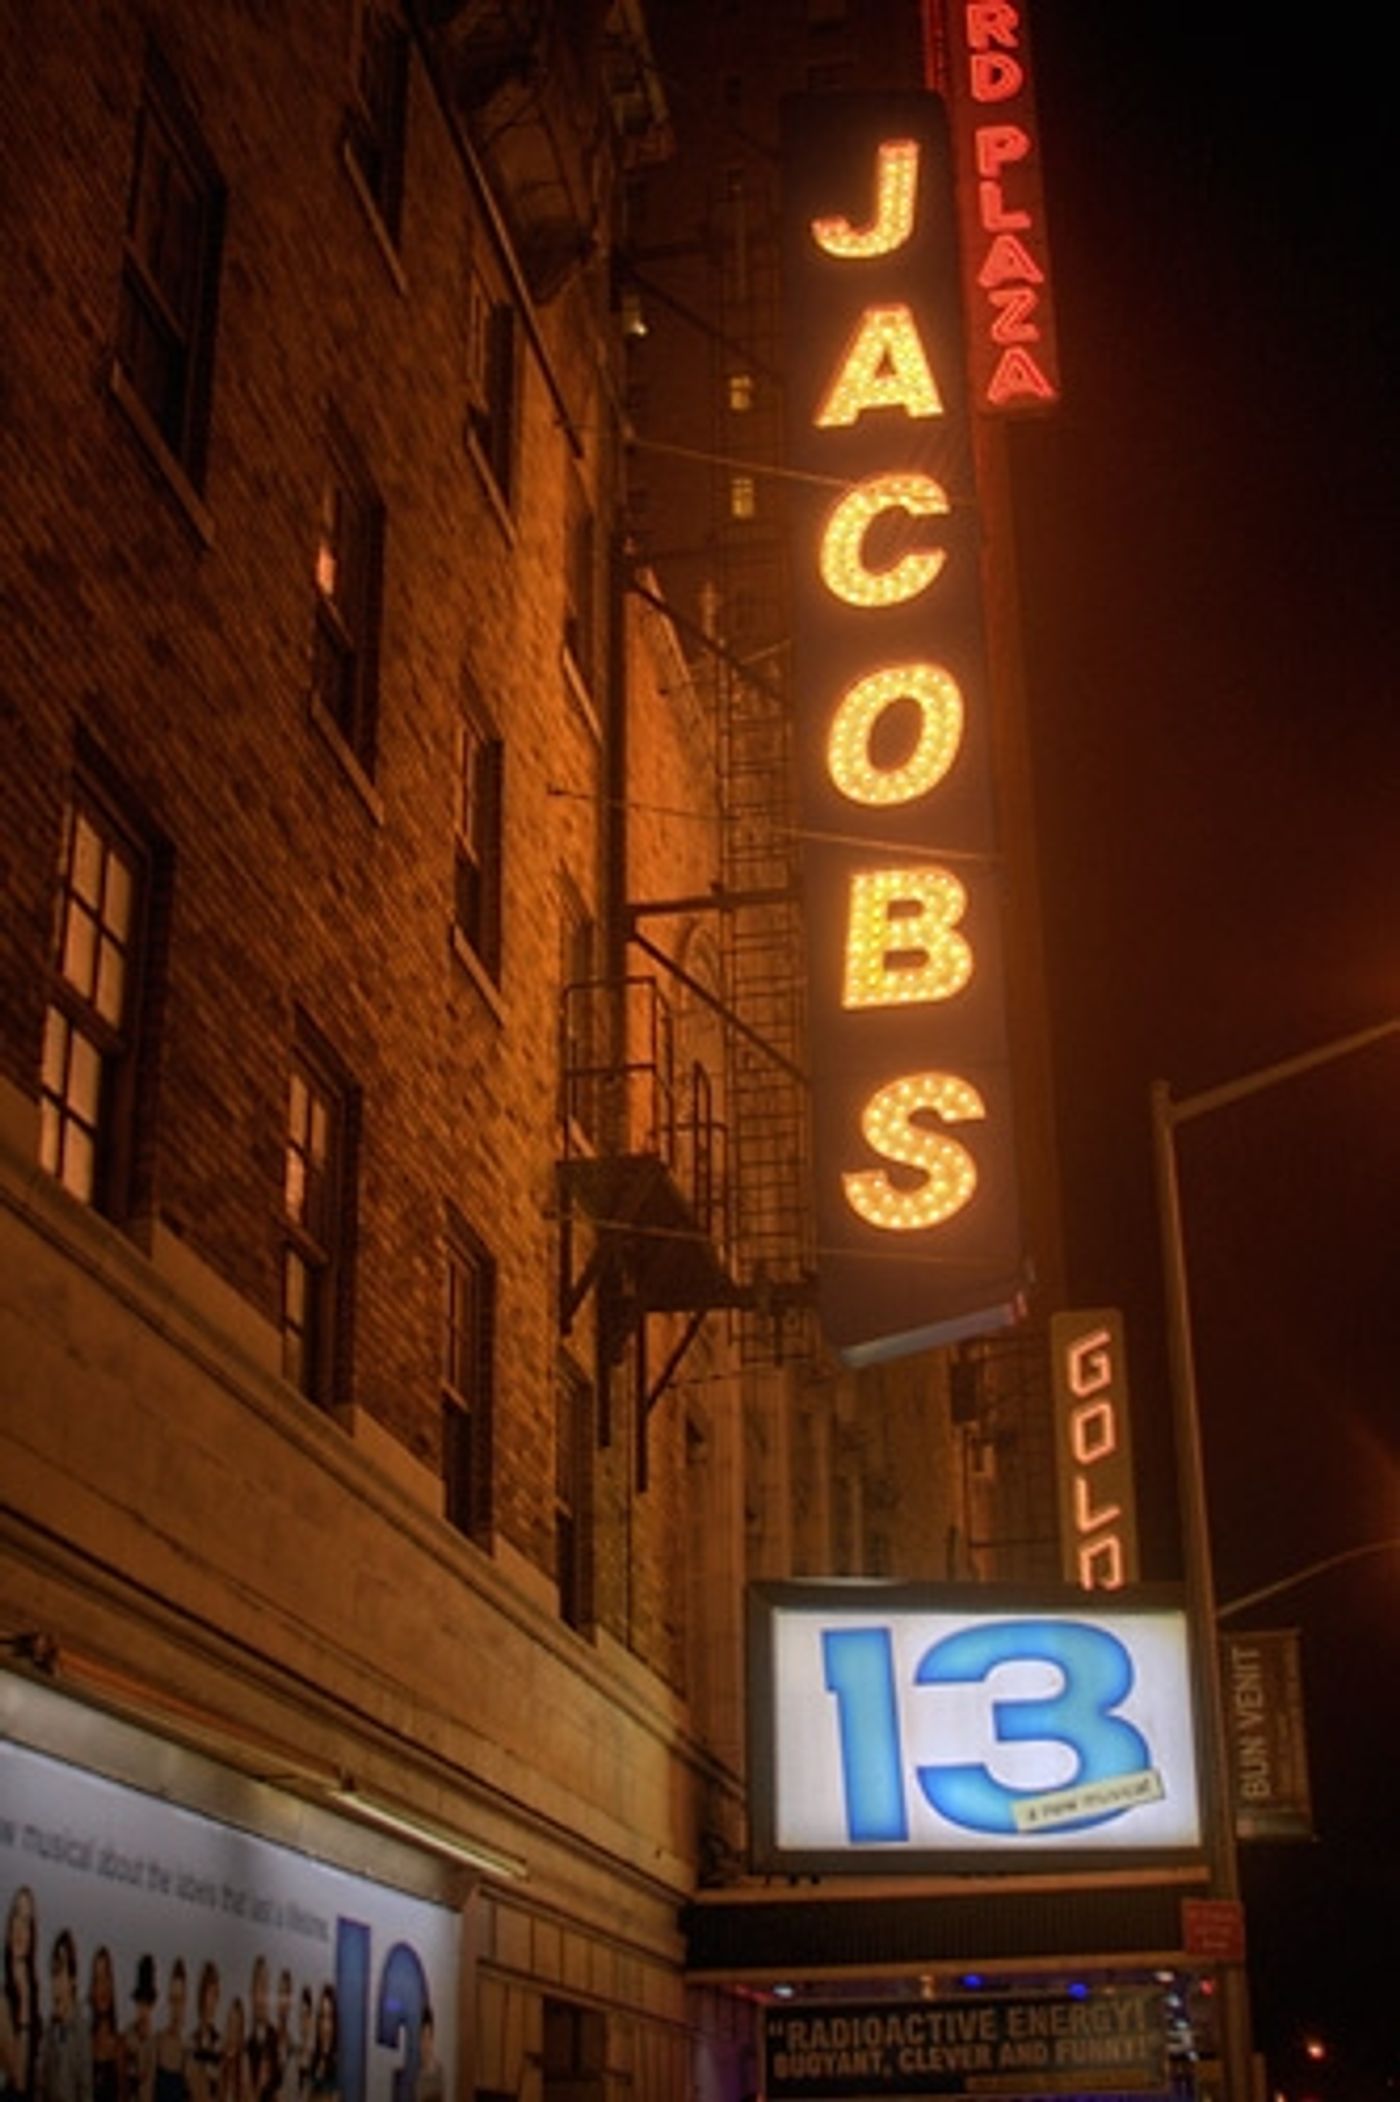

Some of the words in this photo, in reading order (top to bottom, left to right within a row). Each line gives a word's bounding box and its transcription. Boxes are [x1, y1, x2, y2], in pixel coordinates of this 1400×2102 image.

[974, 125, 1054, 406] PLAZA
[810, 137, 987, 1230] JACOBS
[1066, 1331, 1125, 1590] GOLD
[820, 1619, 1152, 1842] 13
[1232, 1646, 1265, 1728] VENIT
[1236, 1731, 1270, 1801] BUN
[897, 2043, 992, 2073] CLEVER
[1001, 2042, 1049, 2065] AND
[1006, 1997, 1147, 2037] ENERGY!
